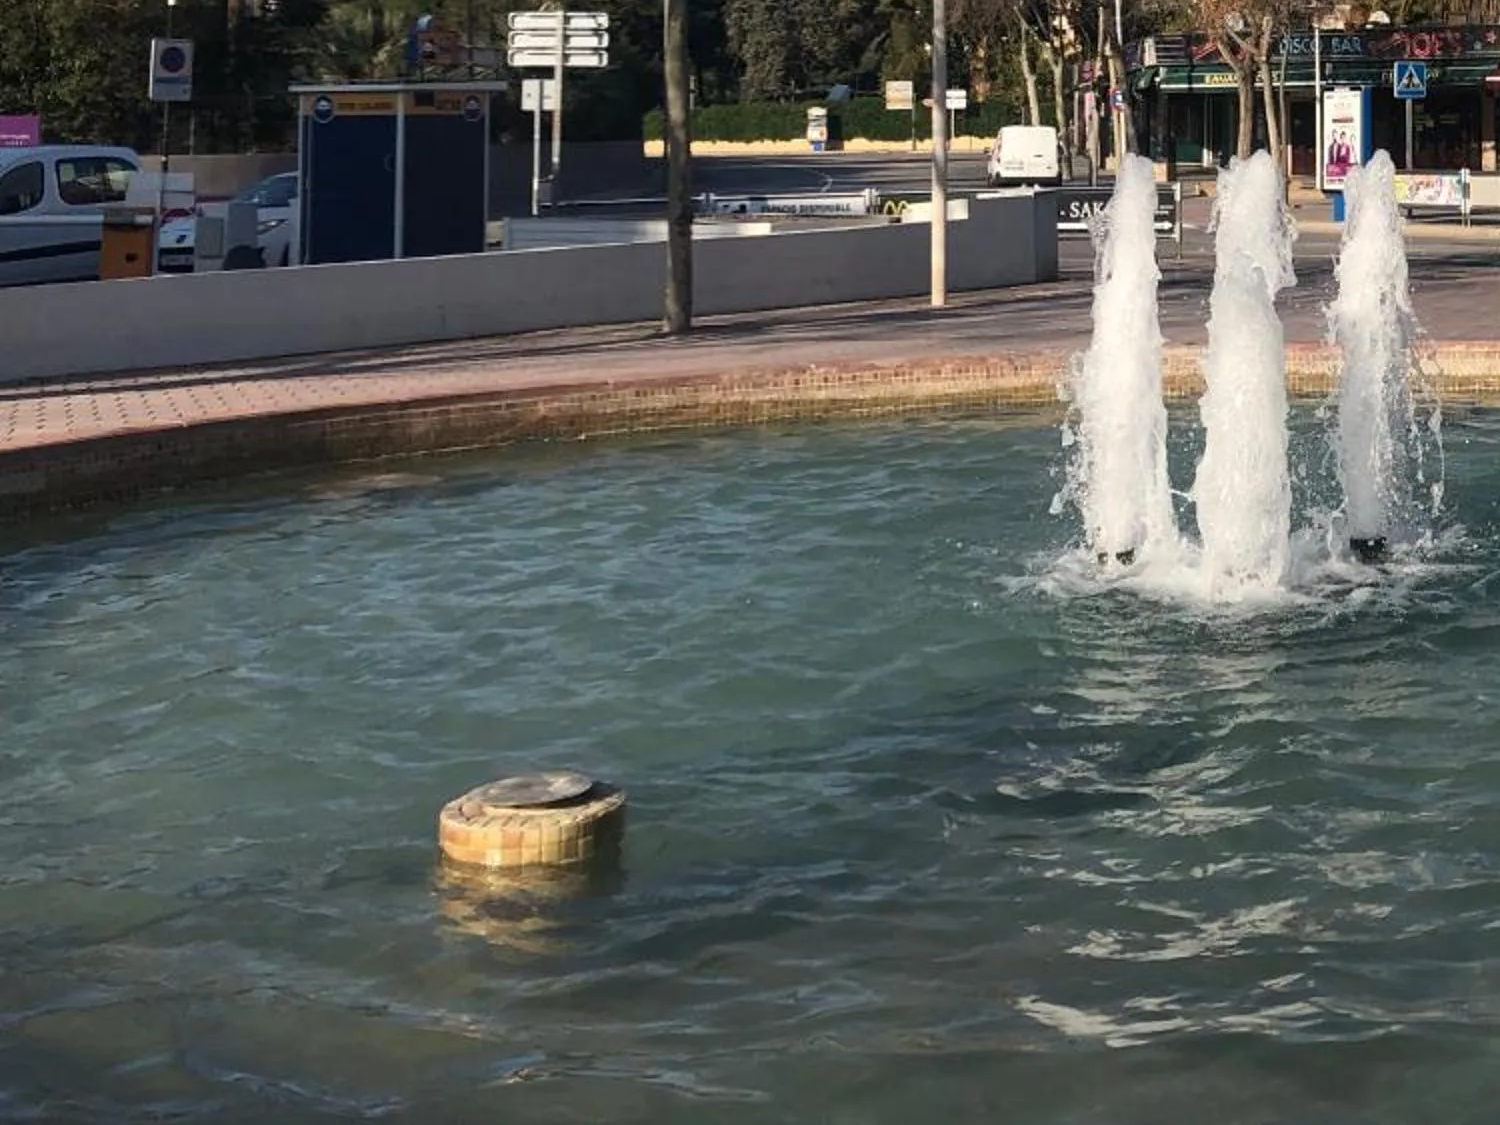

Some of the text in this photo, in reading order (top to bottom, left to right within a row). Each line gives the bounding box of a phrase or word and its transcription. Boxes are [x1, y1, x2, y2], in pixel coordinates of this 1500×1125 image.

[1279, 37, 1321, 54] DISCO
[1331, 36, 1362, 54] BAR
[1069, 200, 1106, 218] SAK
